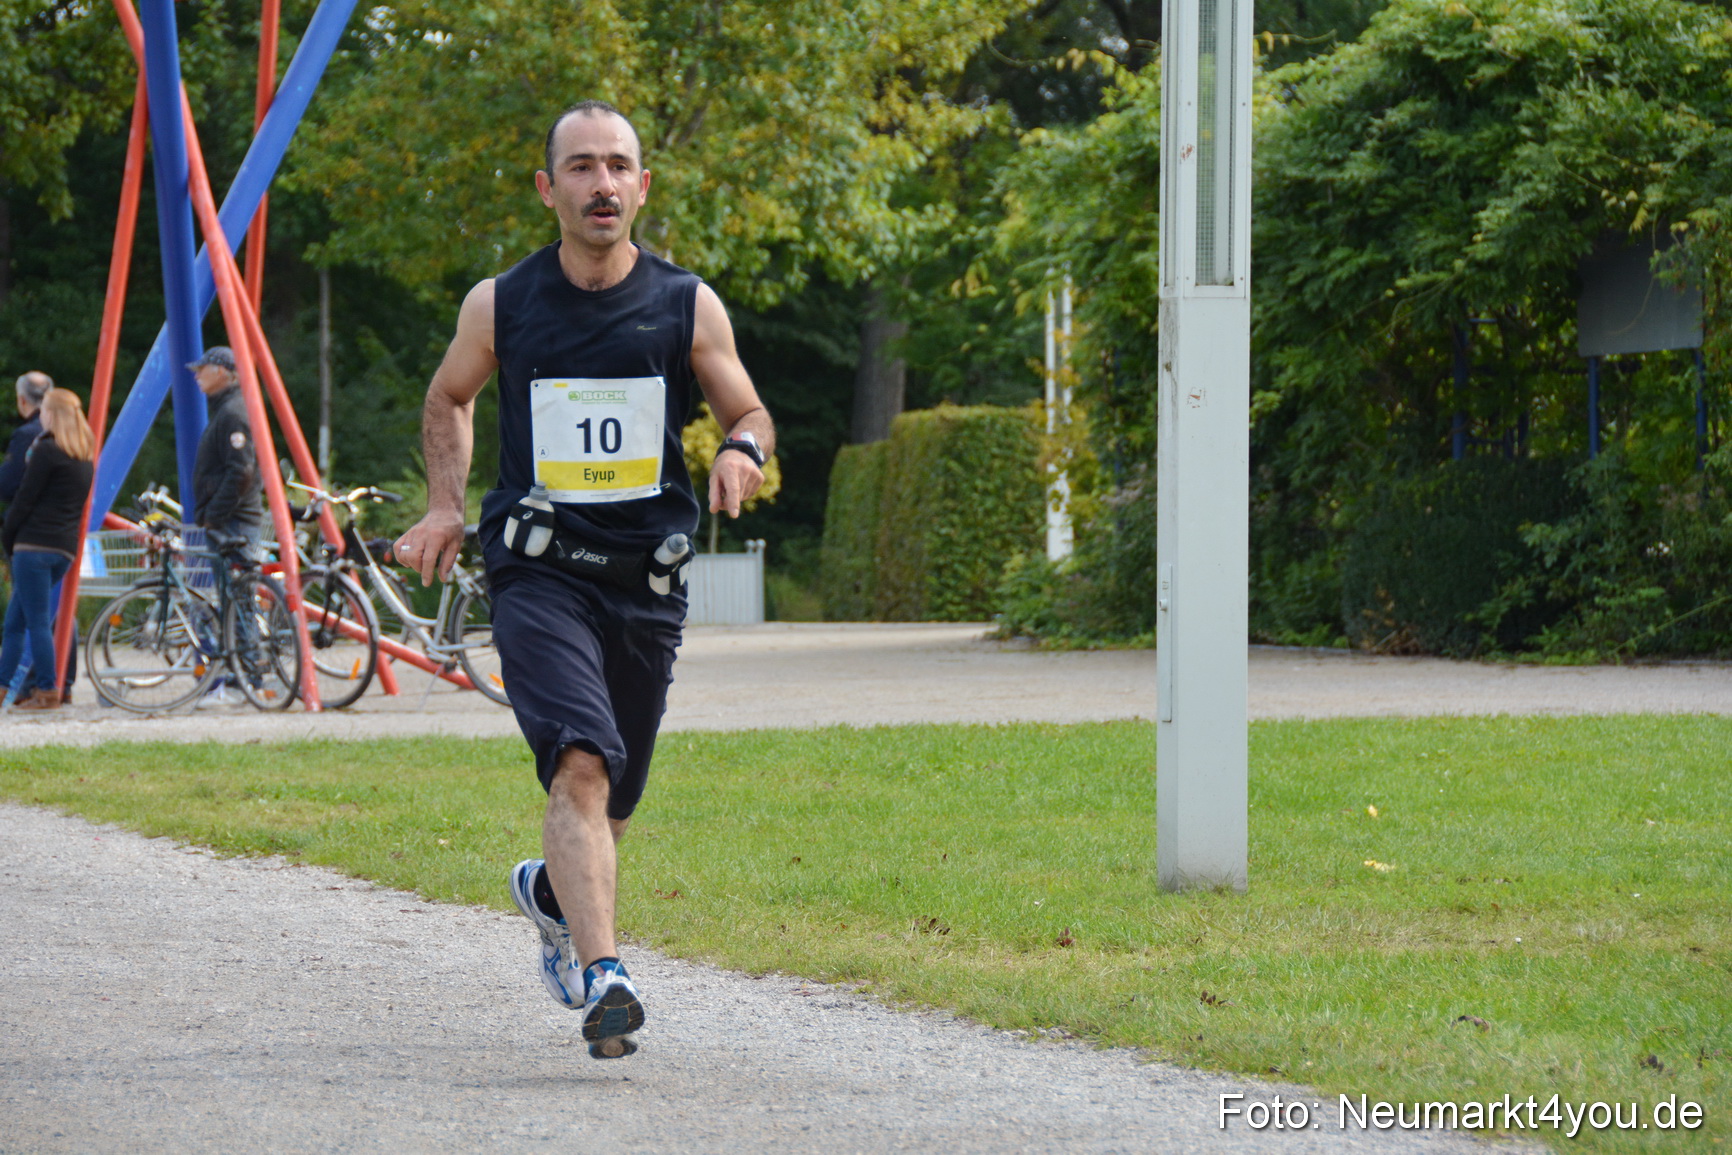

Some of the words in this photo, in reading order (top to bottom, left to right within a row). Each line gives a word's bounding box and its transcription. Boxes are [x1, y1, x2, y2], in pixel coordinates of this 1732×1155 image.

[581, 390, 627, 401] BOCK
[576, 417, 623, 454] 10
[583, 468, 615, 483] Eyup
[583, 553, 609, 565] asics
